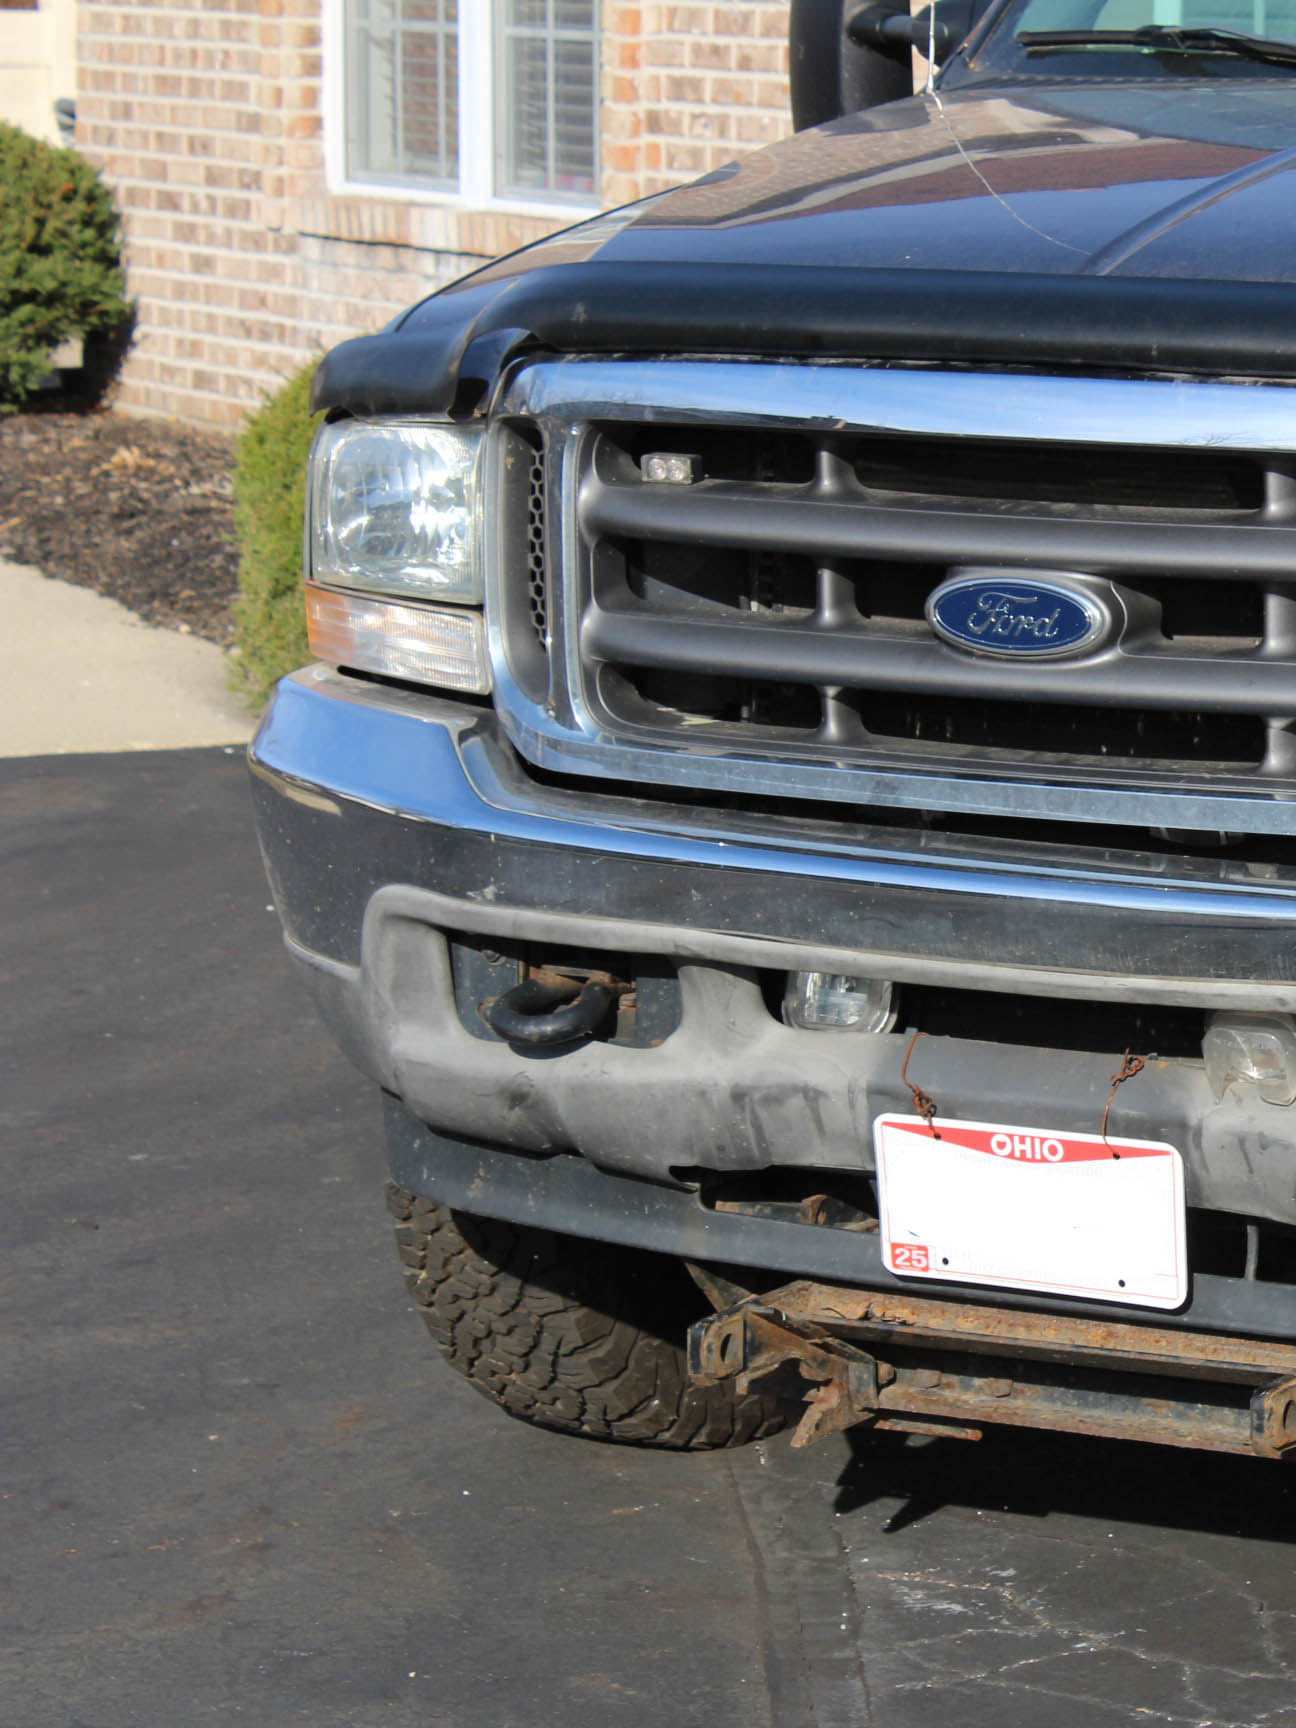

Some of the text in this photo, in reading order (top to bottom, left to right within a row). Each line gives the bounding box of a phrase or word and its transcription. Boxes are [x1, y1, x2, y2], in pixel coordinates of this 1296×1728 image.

[966, 591, 1062, 638] Ford
[990, 1133, 1064, 1162] OHIO
[894, 1247, 928, 1268] 25
